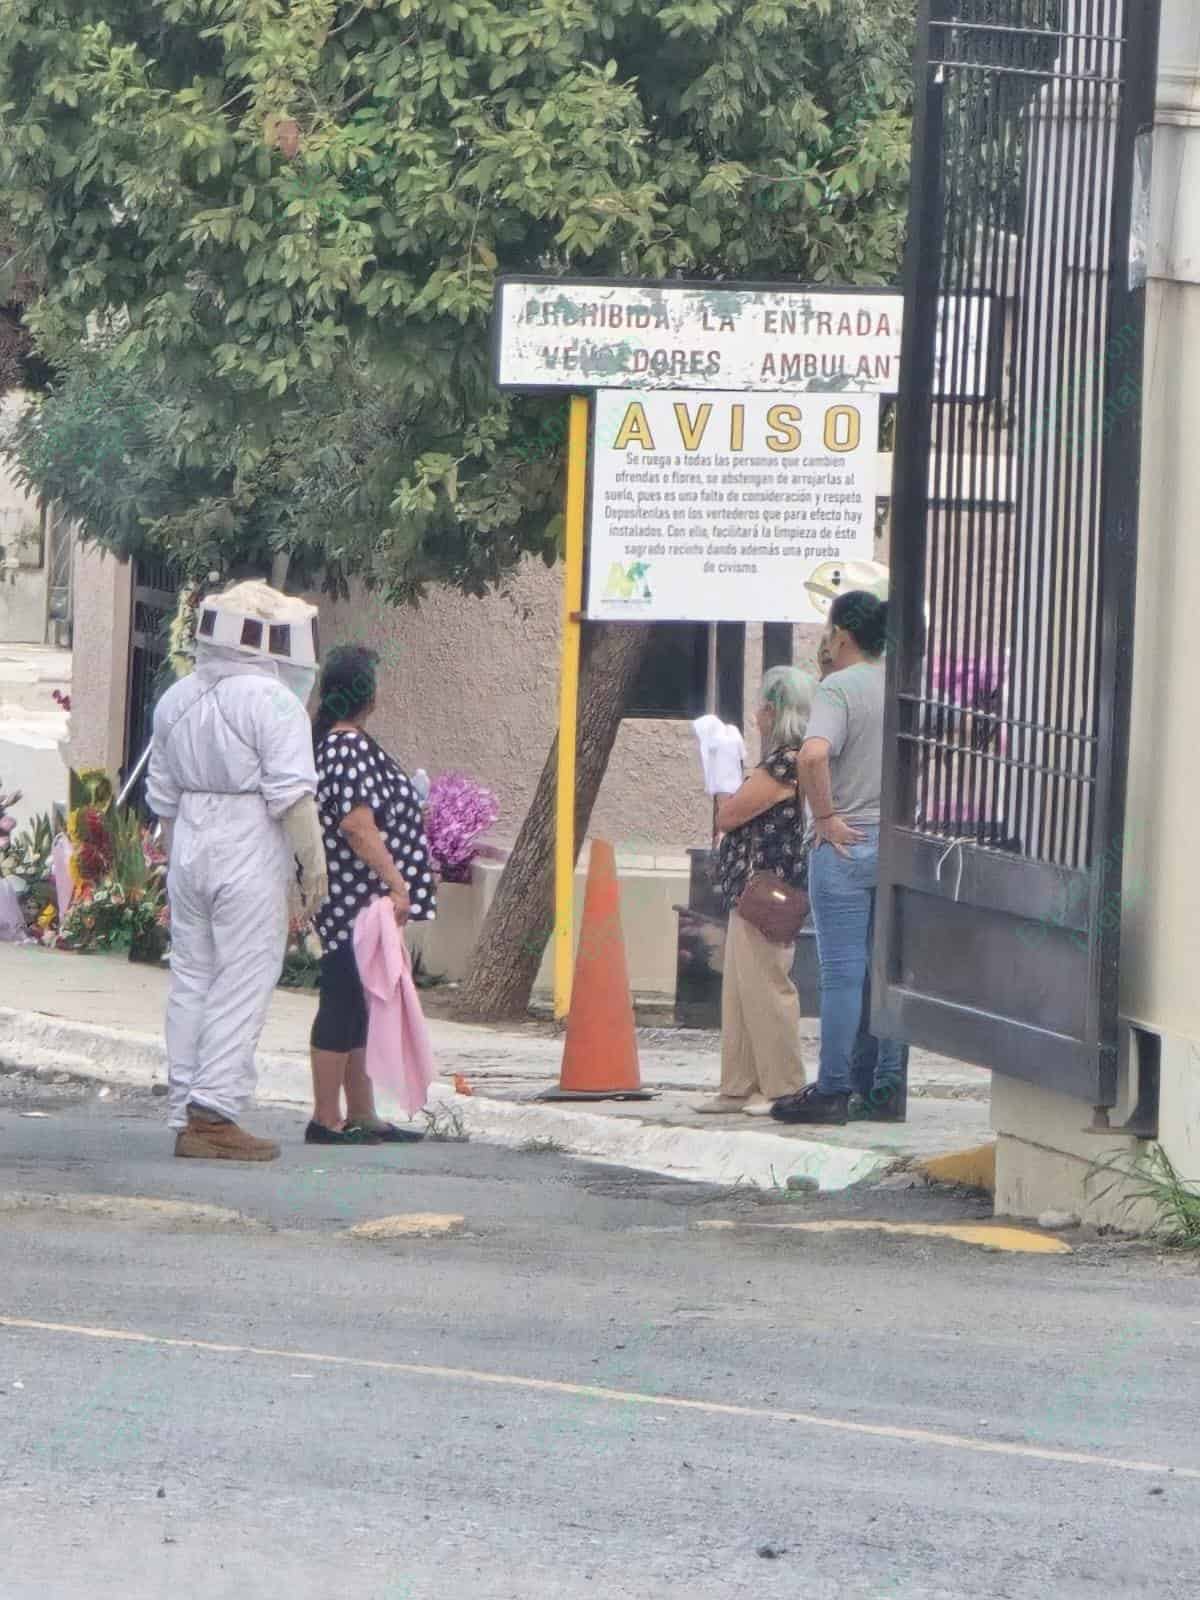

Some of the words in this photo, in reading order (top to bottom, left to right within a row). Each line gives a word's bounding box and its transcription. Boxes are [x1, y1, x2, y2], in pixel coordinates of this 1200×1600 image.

[524, 300, 670, 329] PROHIBIDA
[763, 309, 891, 337] ENTRADA
[613, 401, 861, 452] AVISO
[626, 453, 639, 465] Se
[642, 456, 671, 468] ruega
[684, 453, 711, 466] todas
[715, 454, 730, 466] las
[733, 457, 778, 469] personas
[782, 457, 799, 469] que
[616, 471, 660, 483] ofrendas
[706, 475, 718, 484] se
[777, 472, 788, 485] de
[792, 473, 842, 488] arrojarlas
[845, 473, 854, 485] al
[638, 492, 661, 504] pues
[664, 492, 675, 501] es
[700, 489, 724, 501] falta
[727, 489, 739, 502] de
[815, 493, 821, 505] y
[673, 510, 685, 520] en
[688, 508, 703, 520] los
[707, 508, 760, 520] vertederos
[763, 511, 781, 523] que
[784, 511, 807, 523] para
[810, 509, 841, 521] efecto
[844, 509, 862, 524] hay
[668, 525, 685, 538] Con
[762, 526, 771, 539] la
[820, 527, 832, 539] de
[706, 544, 737, 556] dando
[804, 545, 839, 560] prueba
[704, 561, 715, 574] de
